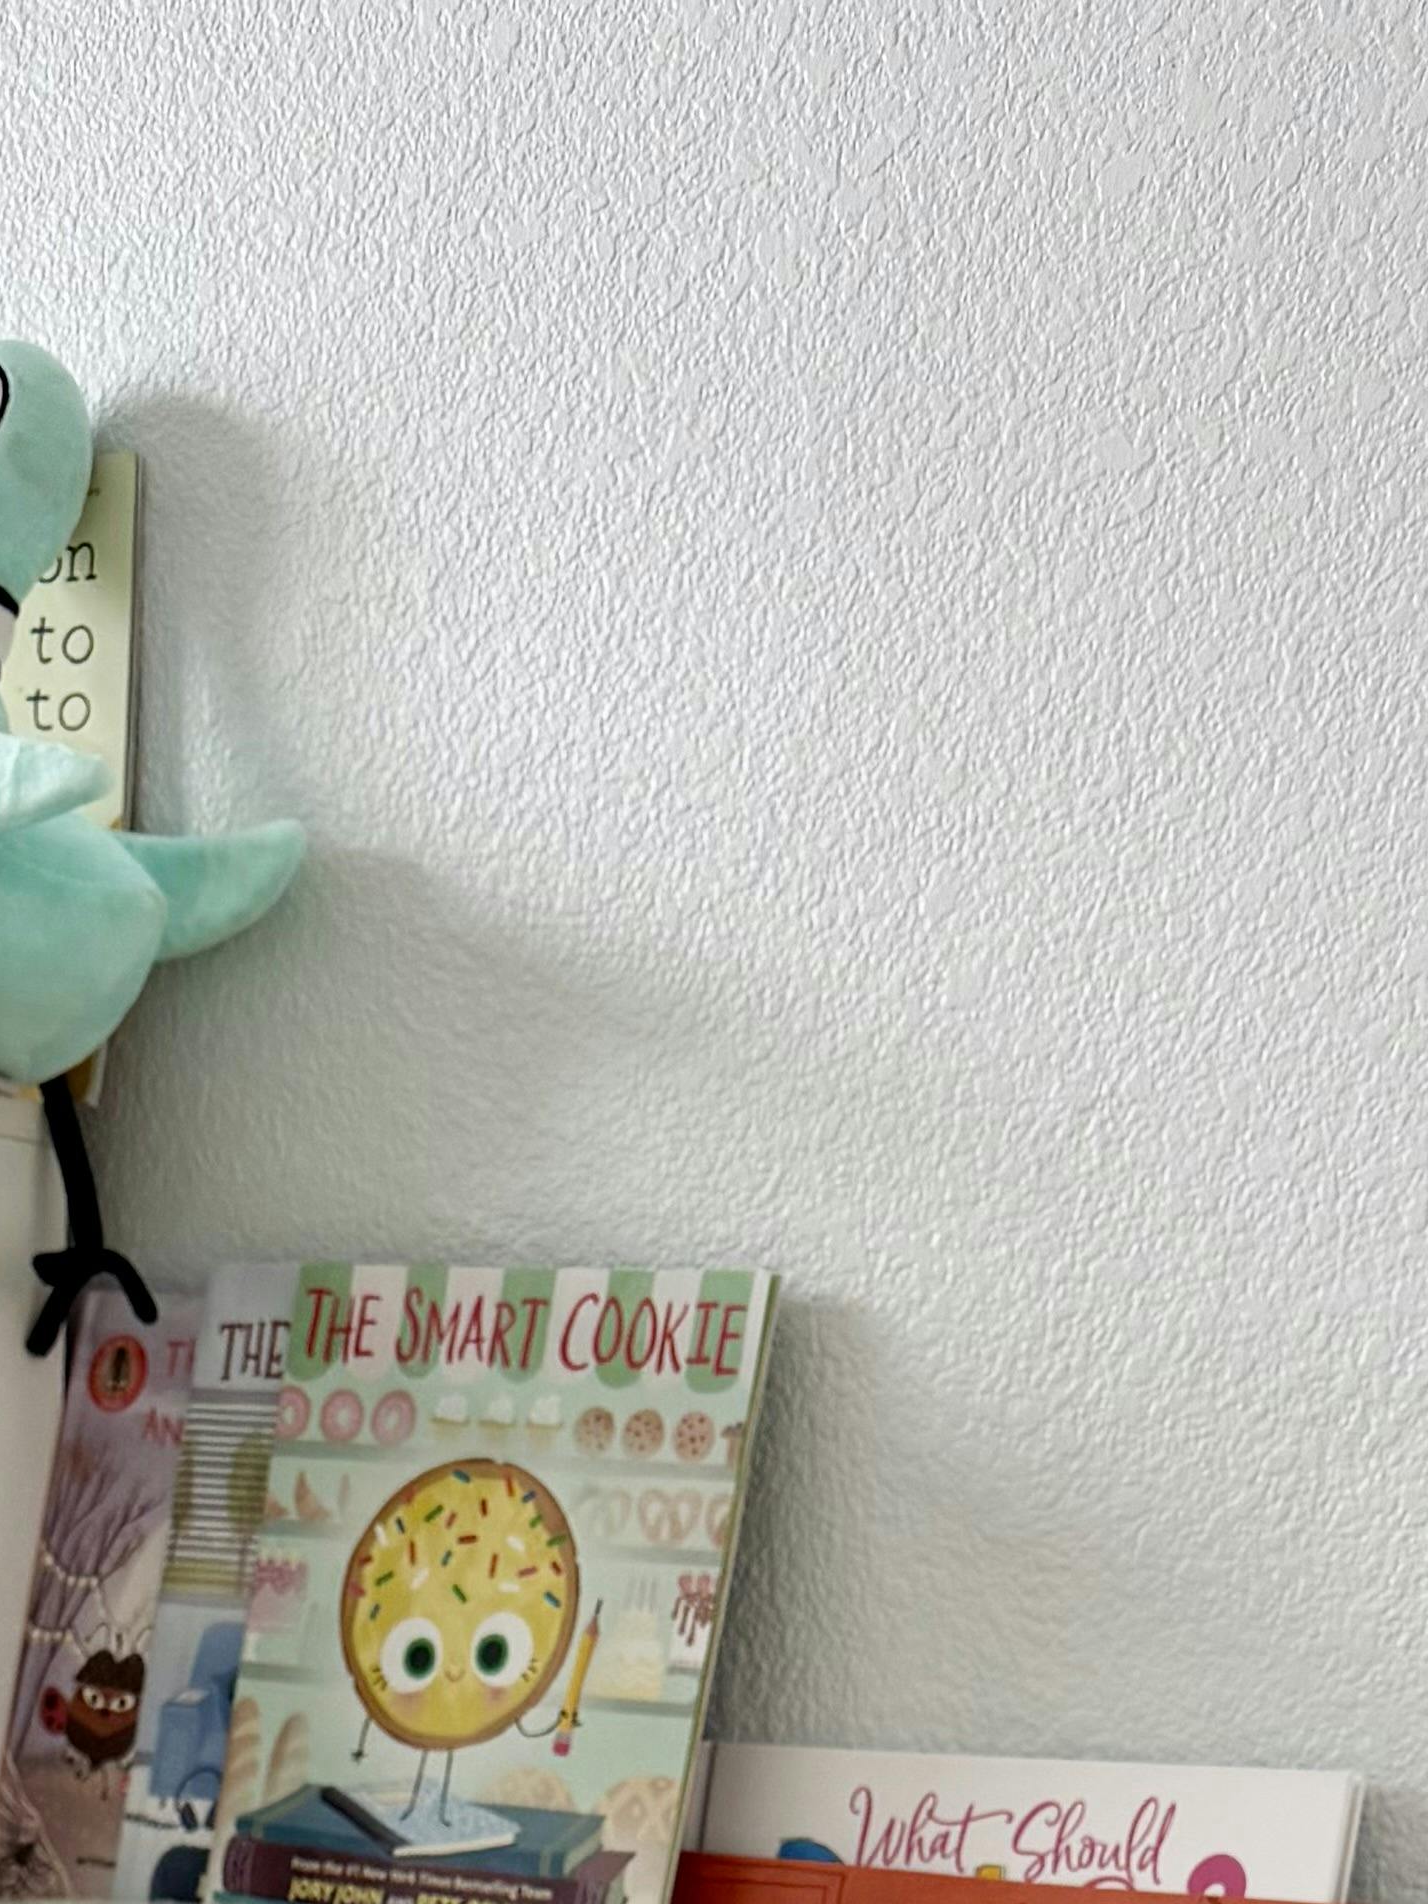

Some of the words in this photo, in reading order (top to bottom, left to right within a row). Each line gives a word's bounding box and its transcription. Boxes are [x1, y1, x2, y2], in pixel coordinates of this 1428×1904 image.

[30, 616, 95, 665] to
[25, 688, 92, 733] to
[219, 1320, 292, 1382] THE
[305, 1286, 382, 1364] THE
[394, 1284, 552, 1371] SMART
[558, 1291, 749, 1378] COOKIE
[849, 1786, 1013, 1873] What
[1011, 1796, 1178, 1885] Should
[288, 1877, 336, 1902] JORY
